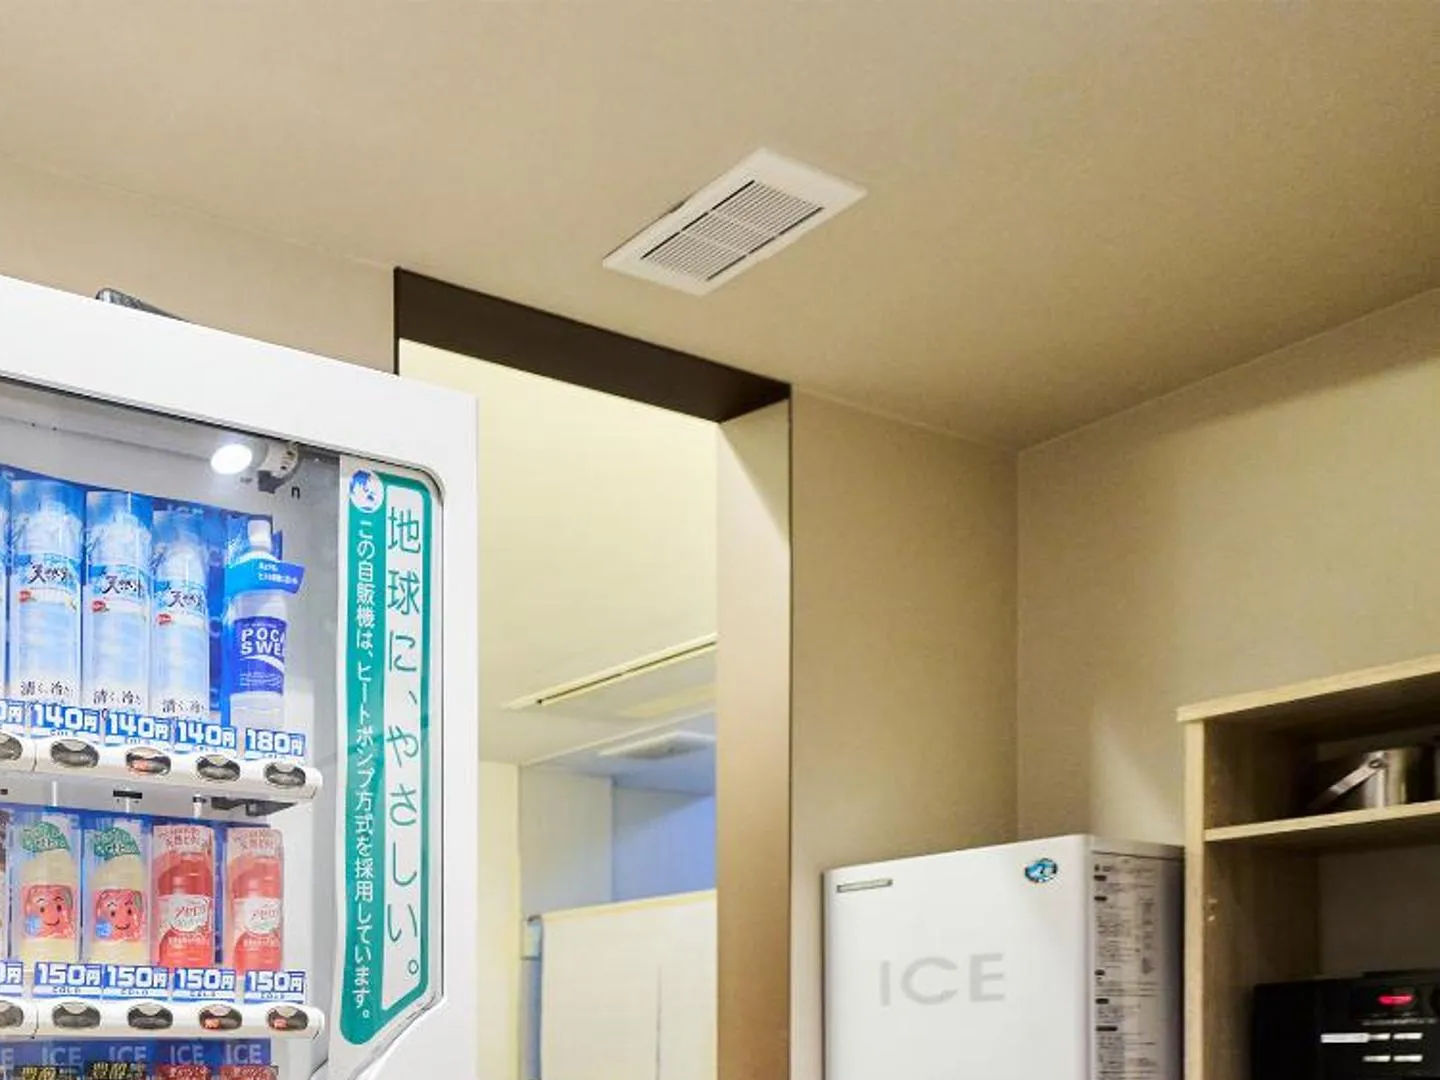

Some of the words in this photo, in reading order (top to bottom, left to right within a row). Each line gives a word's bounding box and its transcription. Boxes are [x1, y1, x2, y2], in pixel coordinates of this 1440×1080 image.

[34, 704, 98, 732] 140円
[110, 712, 169, 740] 140円
[178, 720, 235, 748] 140円
[387, 506, 421, 975] 地球に、やさしい。
[38, 964, 100, 987] 150円
[107, 966, 166, 988] 150円
[177, 969, 235, 990] 150円
[247, 971, 302, 993] 150円
[880, 953, 1006, 1007] ICE
